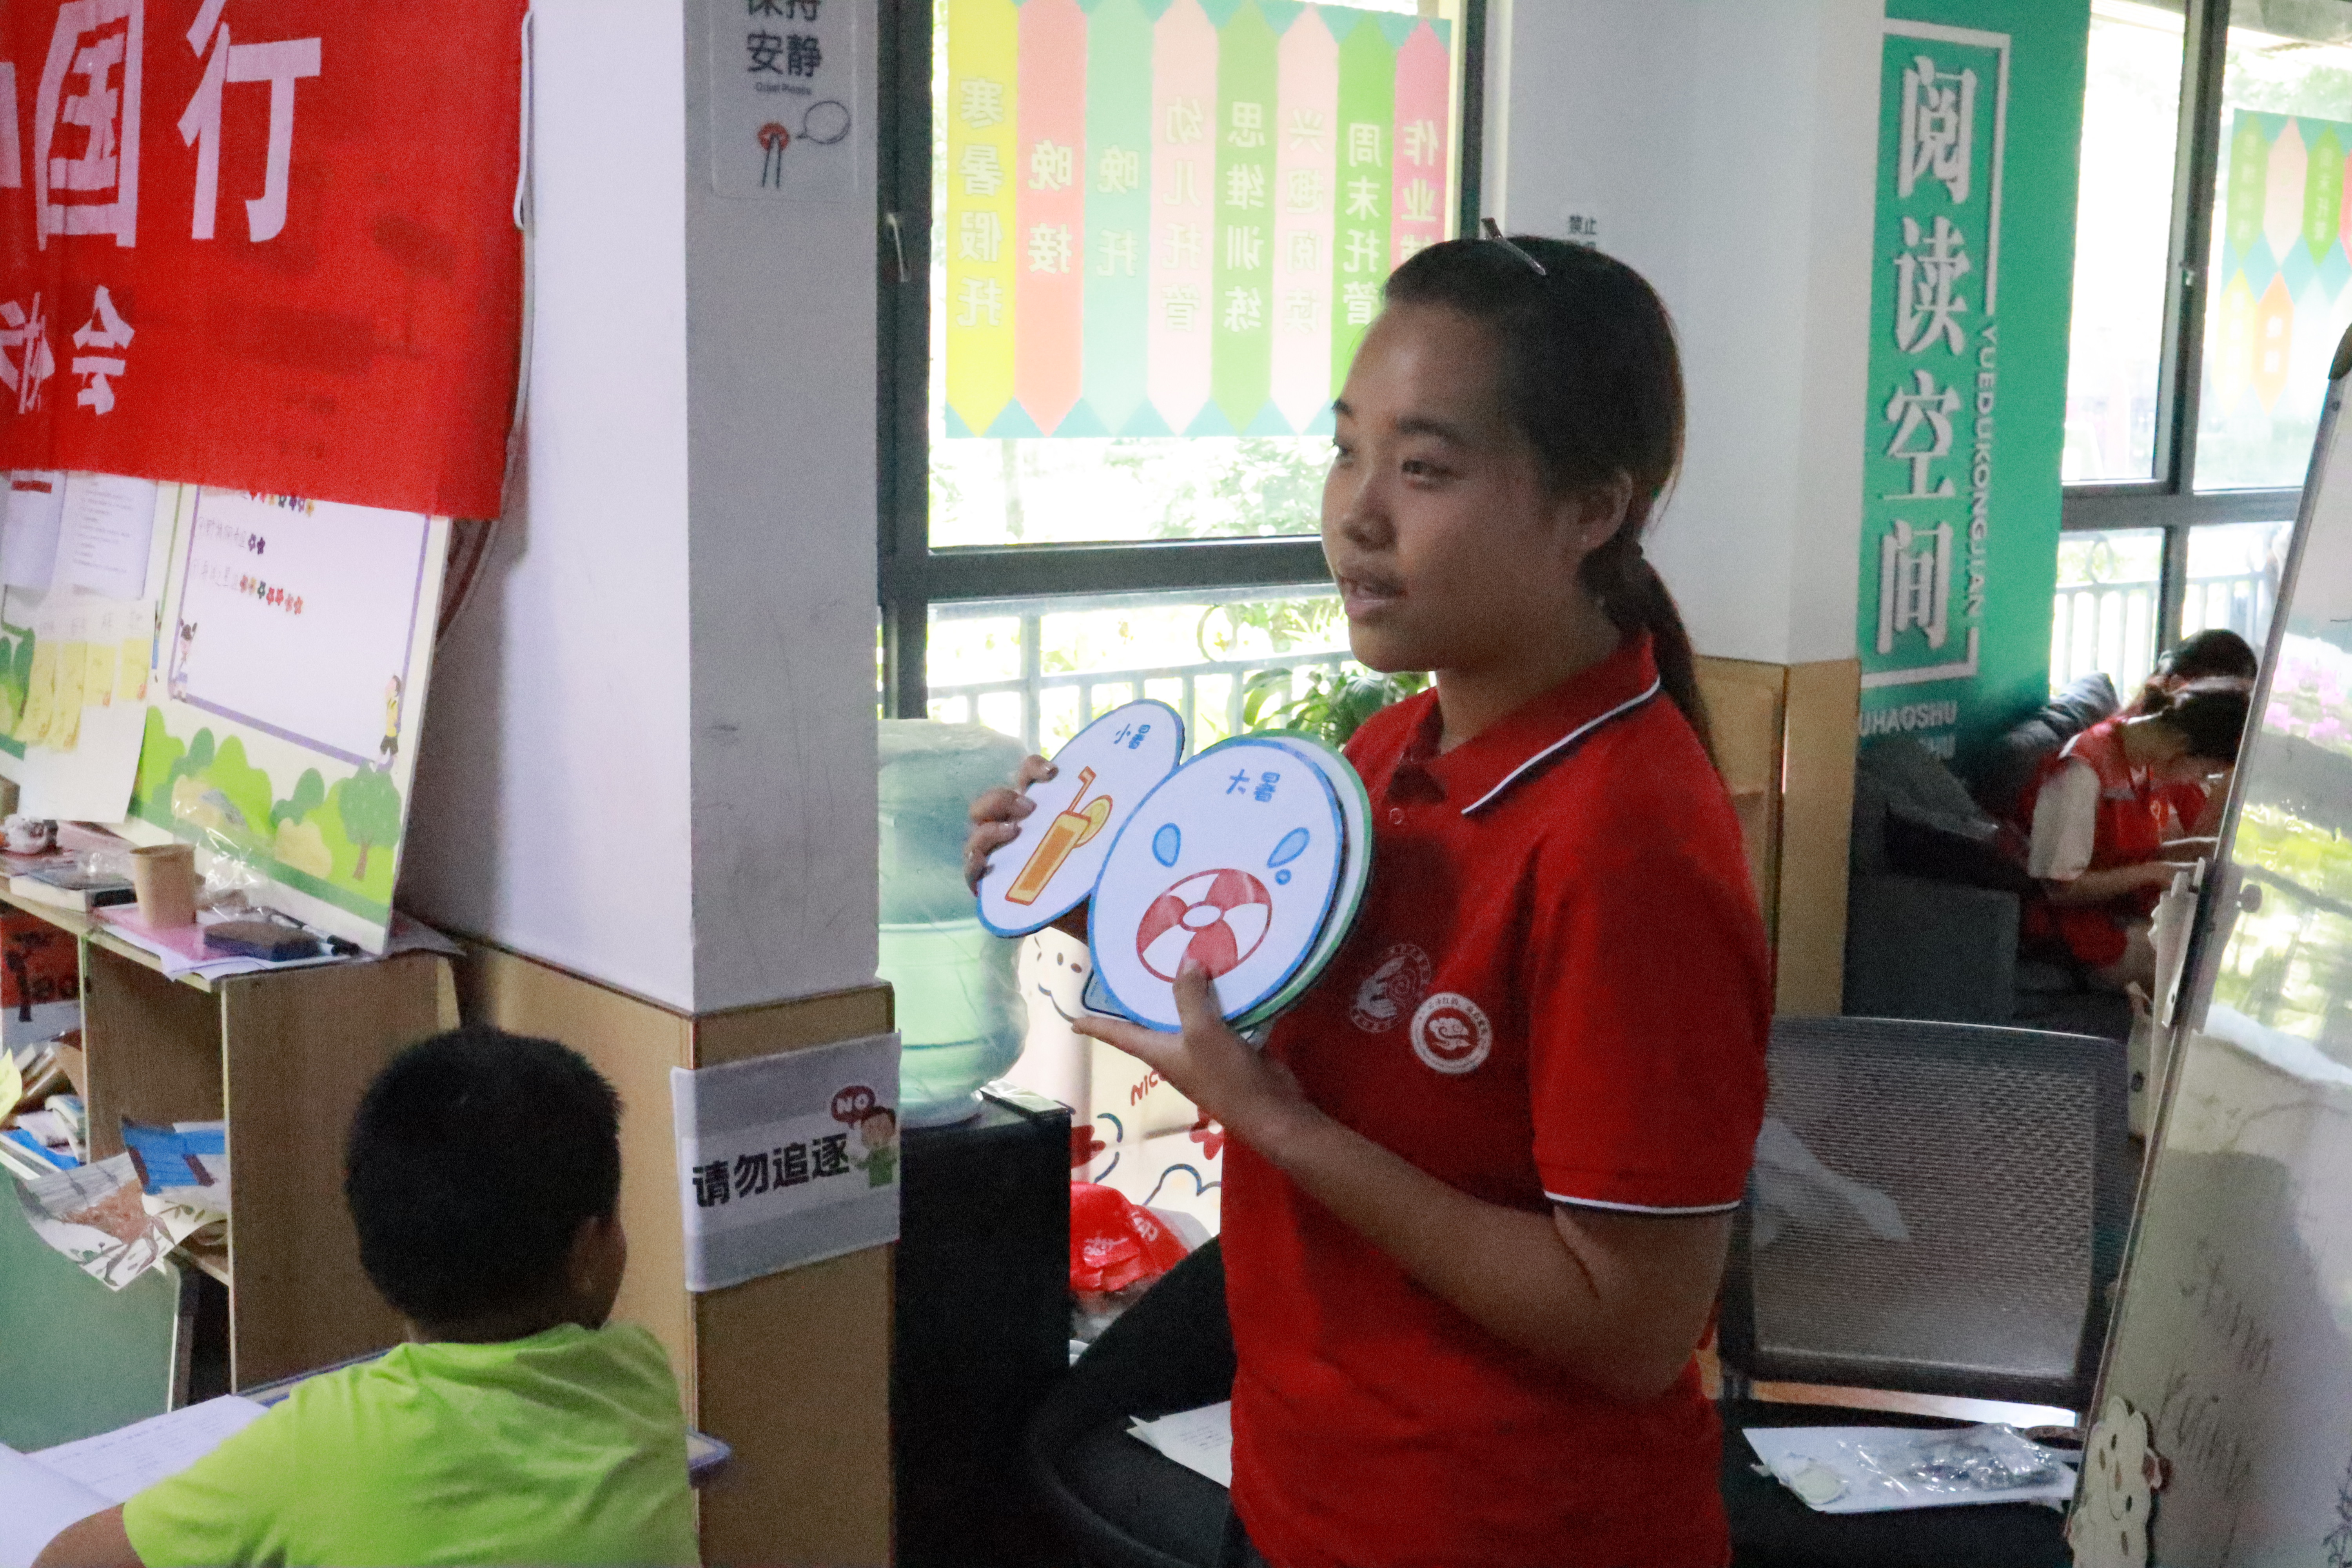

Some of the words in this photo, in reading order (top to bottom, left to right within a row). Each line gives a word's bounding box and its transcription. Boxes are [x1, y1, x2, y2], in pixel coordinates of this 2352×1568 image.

[747, 30, 822, 78] 安静
[0, 0, 321, 251] 国行
[1877, 55, 1978, 656] 阅读空间
[1965, 325, 1997, 617] YUEDUKONGJIAN
[1114, 724, 1151, 750] 小暑
[1226, 769, 1280, 802] 大暑
[837, 1093, 867, 1113] NO
[1131, 1069, 1167, 1107] NIC
[692, 1133, 849, 1207] 请勿追逐
